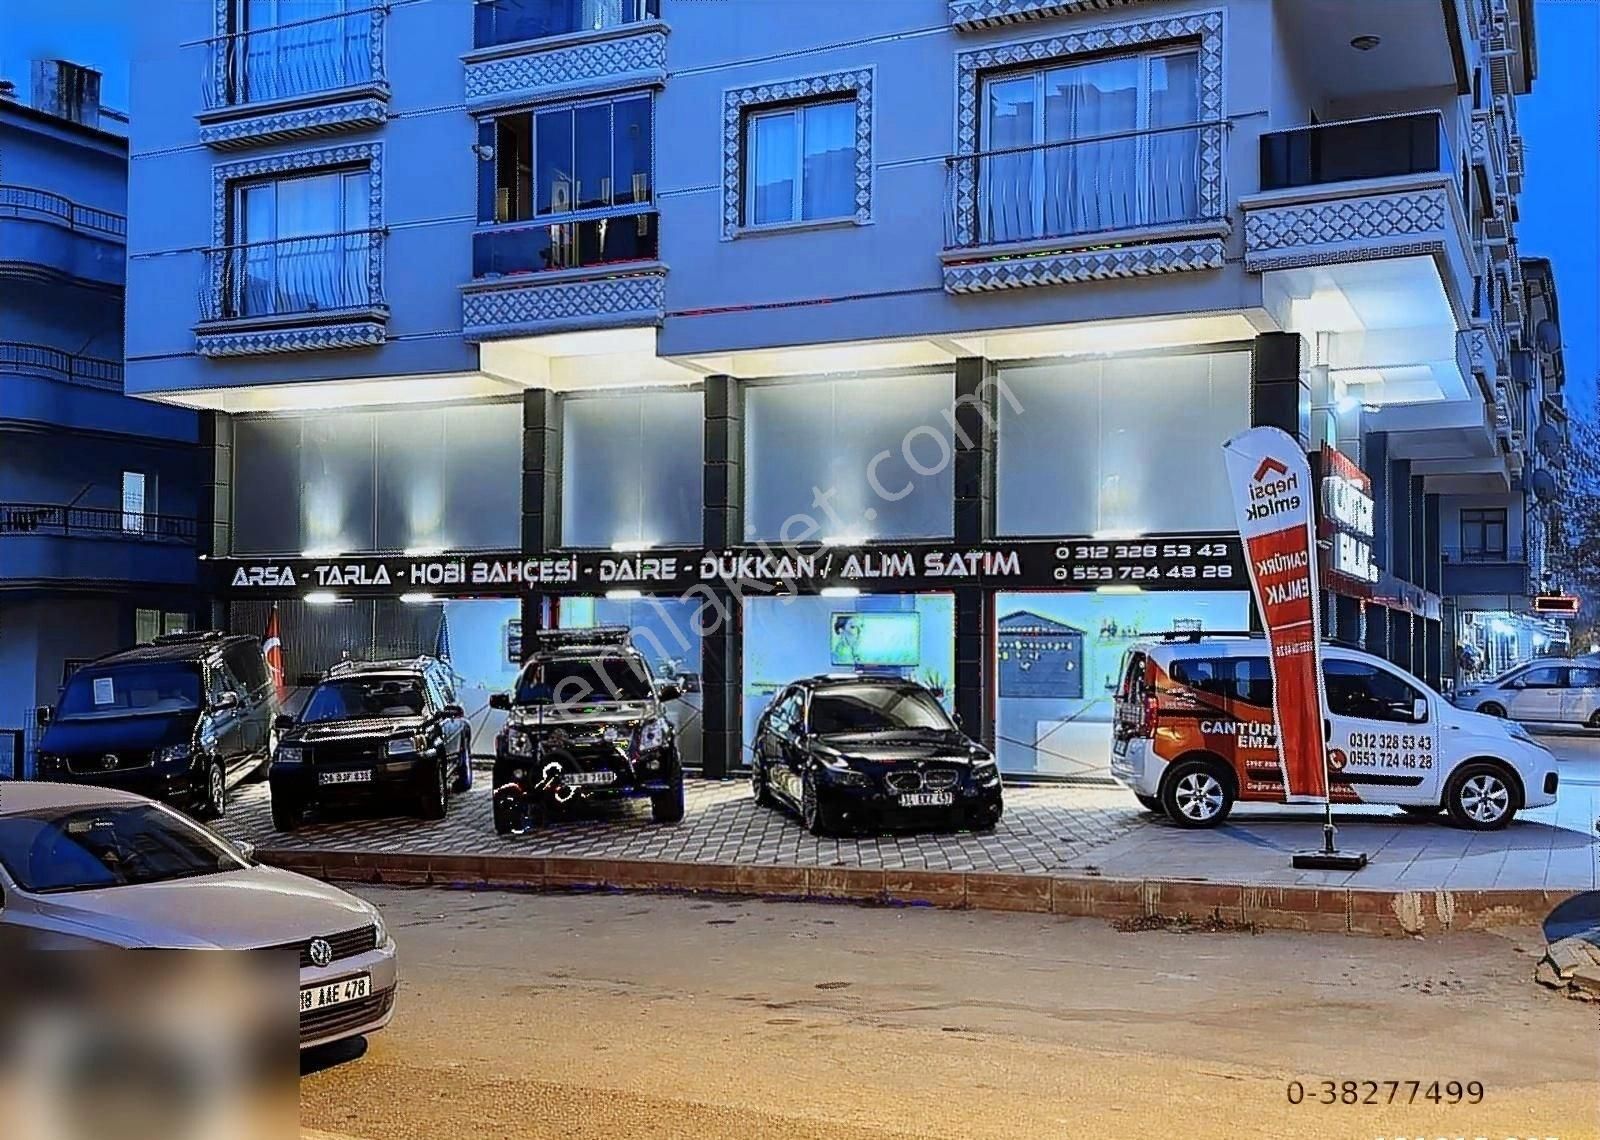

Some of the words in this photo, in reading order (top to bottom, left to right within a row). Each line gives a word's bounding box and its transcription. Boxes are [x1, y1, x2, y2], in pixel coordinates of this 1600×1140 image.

[1075, 546, 1109, 559] 312
[1114, 545, 1157, 558] 328
[1163, 545, 1191, 557] 53
[1197, 544, 1228, 556] 43
[231, 566, 297, 586] ARSA
[314, 564, 392, 586] TARLA
[410, 557, 466, 584] HOBİ
[472, 554, 578, 590] BAHÇESİ
[600, 553, 678, 581] DAİRE
[700, 551, 816, 580] DÜKKAN
[840, 552, 916, 578] ALIM
[923, 551, 1021, 576] SATIM
[1073, 567, 1113, 580] 553
[1118, 566, 1160, 579] 724
[1166, 566, 1196, 578] 48
[1202, 565, 1233, 578] 28
[1350, 732, 1376, 748] 0312
[1379, 734, 1399, 749] 328
[1402, 735, 1415, 750] 53
[1418, 736, 1432, 751] 43
[1350, 751, 1376, 766] 0553
[1380, 752, 1399, 767] 724
[1402, 753, 1416, 768] 48
[1418, 754, 1433, 769] 28
[318, 985, 340, 1006] AAE
[344, 979, 366, 999] 478
